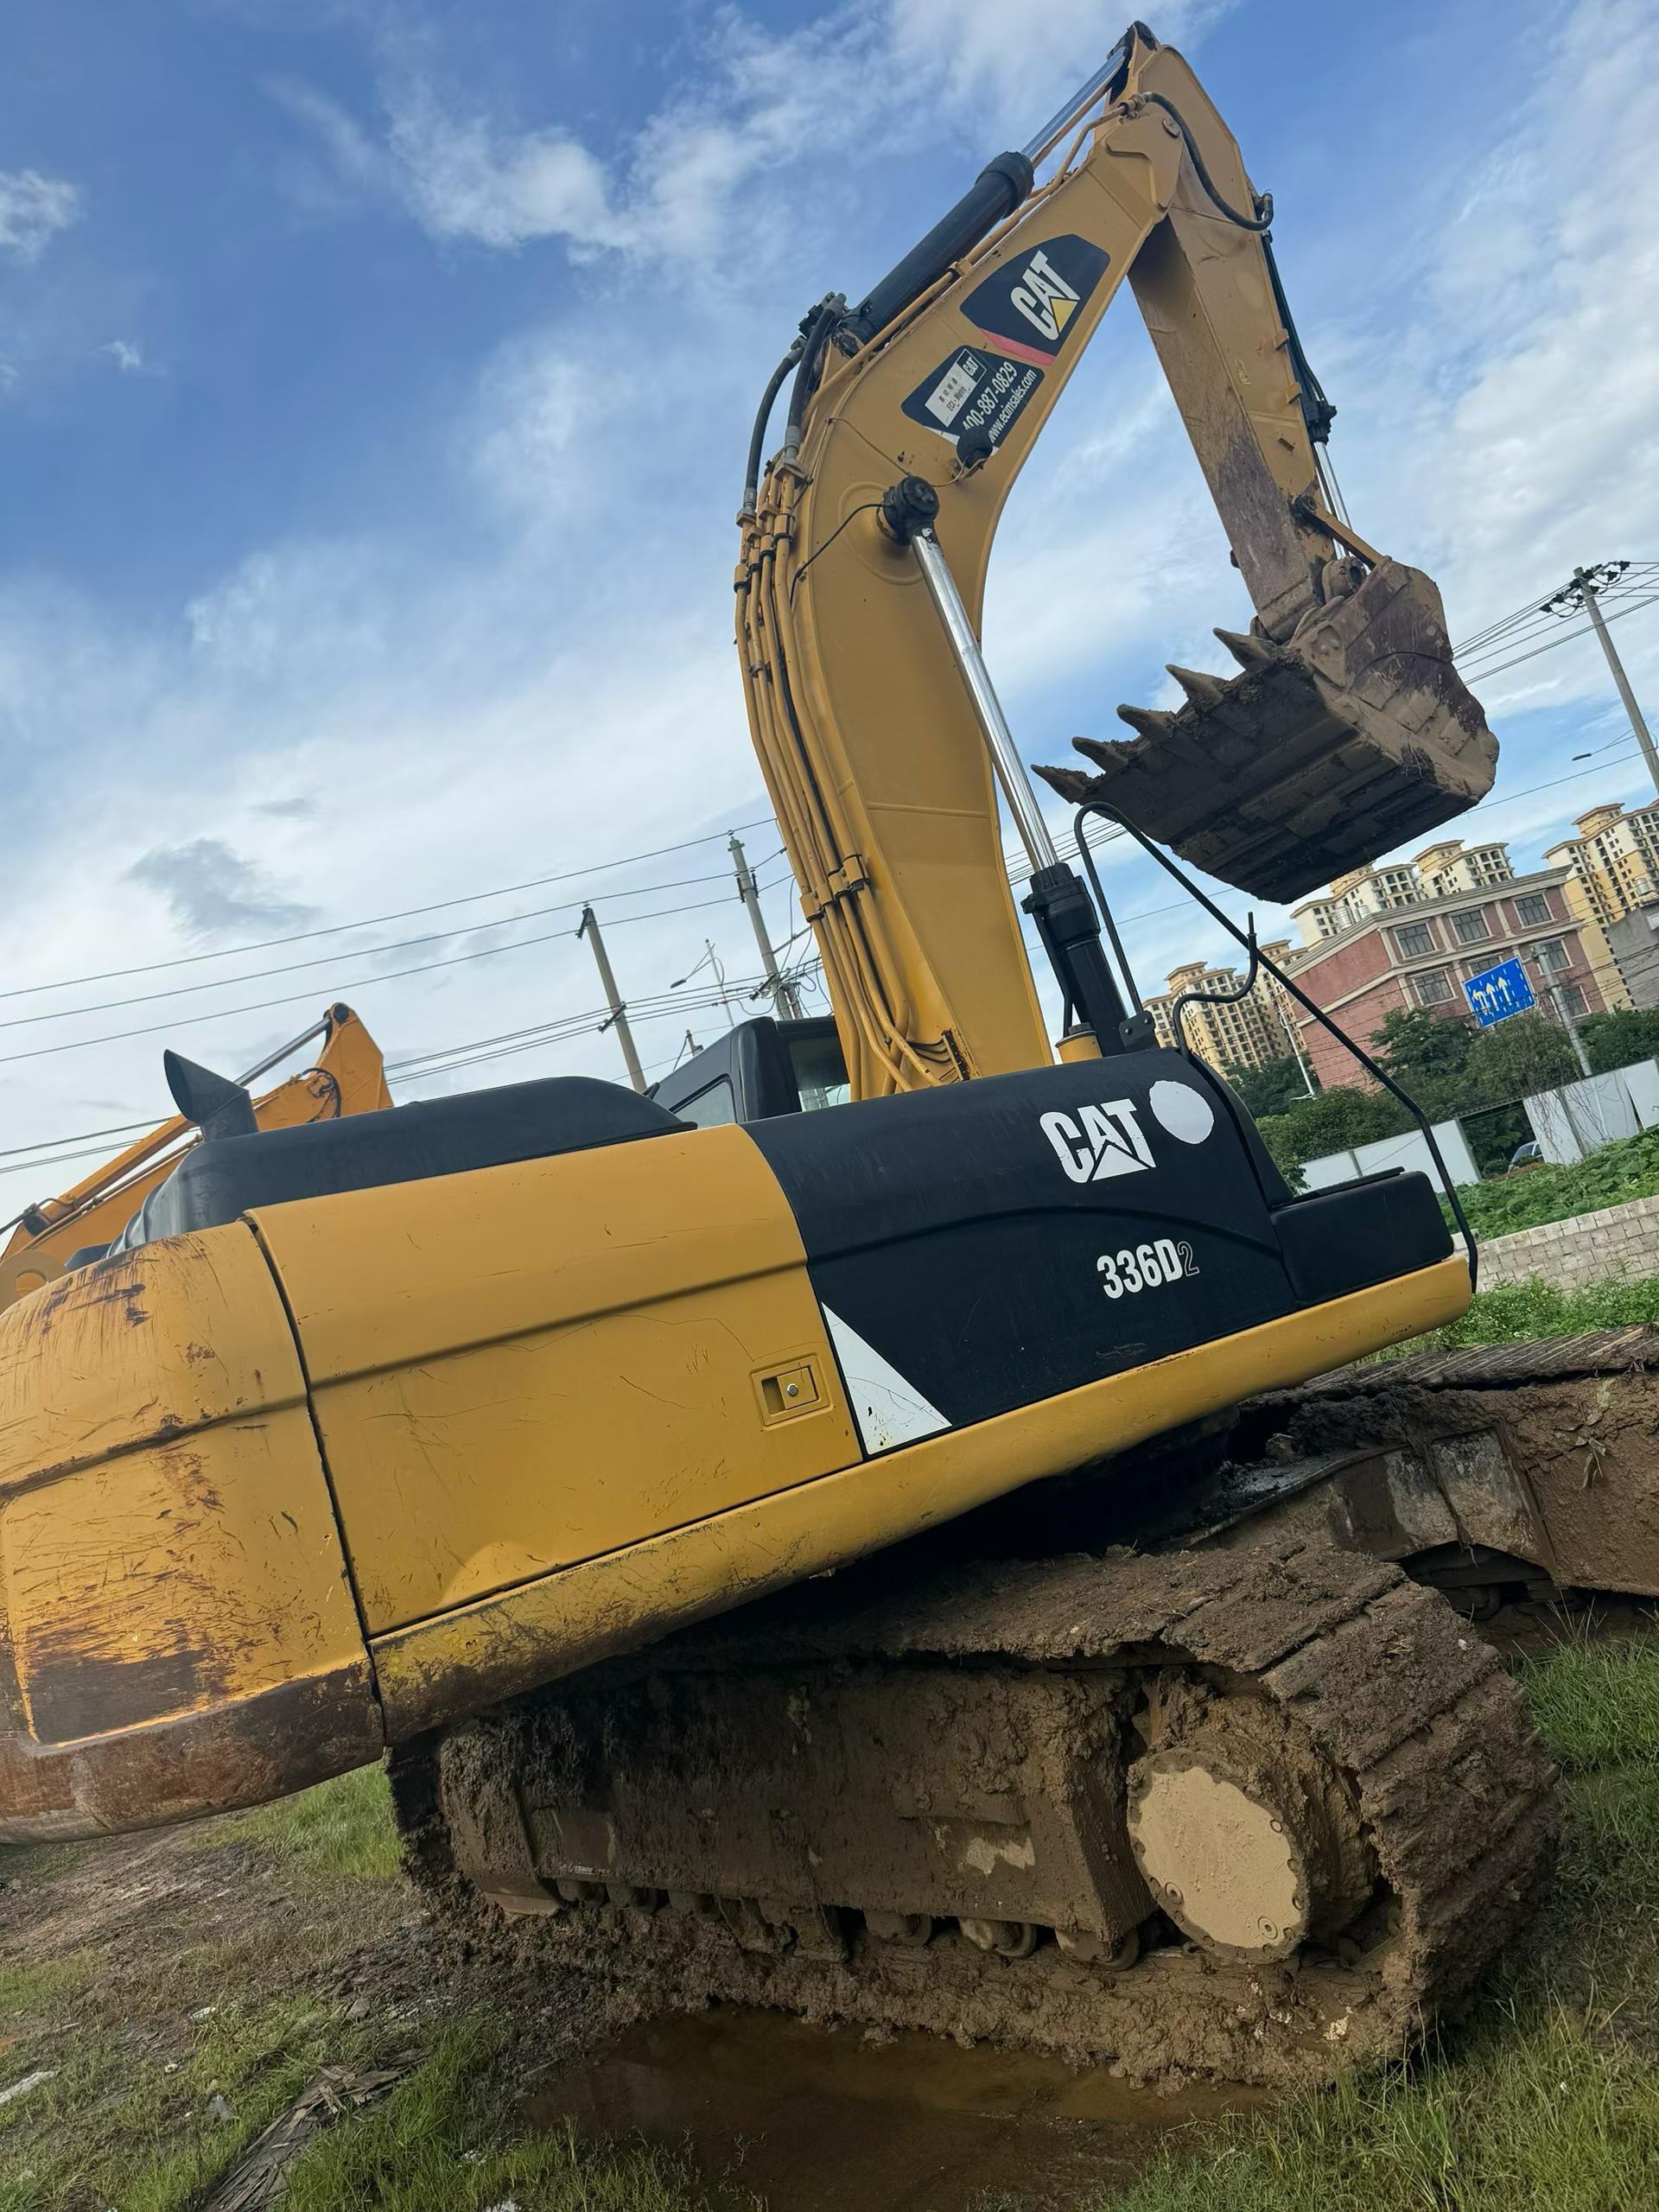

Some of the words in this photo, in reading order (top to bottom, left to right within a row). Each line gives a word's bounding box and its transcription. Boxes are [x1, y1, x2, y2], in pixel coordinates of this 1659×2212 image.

[1011, 250, 1081, 340] CAT
[963, 356, 979, 376] CAT
[1039, 1098, 1157, 1184] CAT
[1096, 1238, 1200, 1300] 336D2
